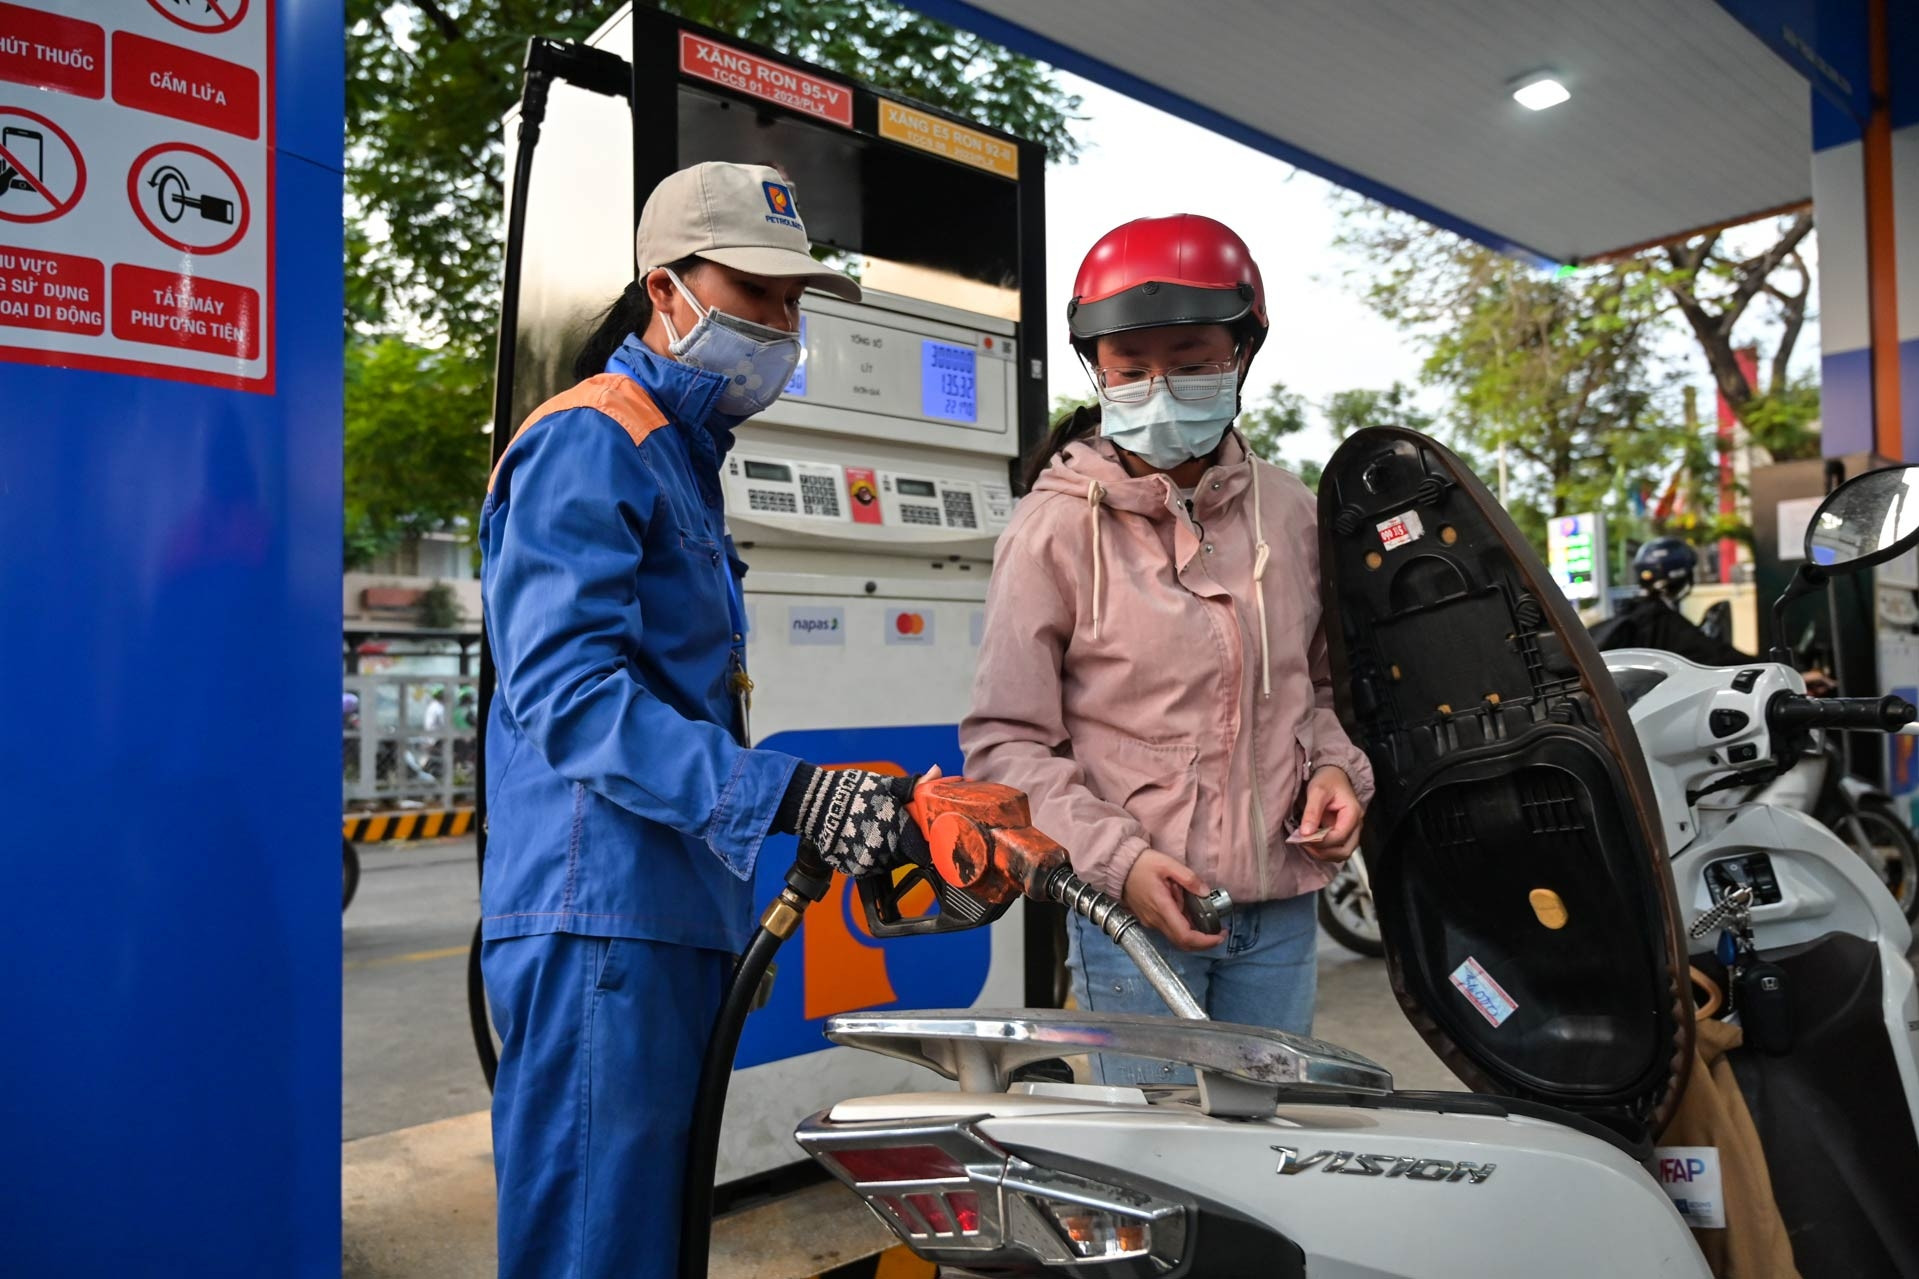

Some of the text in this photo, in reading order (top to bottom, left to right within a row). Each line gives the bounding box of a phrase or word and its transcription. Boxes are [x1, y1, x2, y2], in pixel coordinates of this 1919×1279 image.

[34, 43, 94, 71] THUỐC
[696, 44, 839, 105] XĂNG RON 95-V
[149, 71, 227, 106] CẤM LỬA
[712, 68, 746, 88] TCCS
[750, 81, 763, 93] 01
[774, 89, 825, 114] 2023/PLX
[933, 124, 950, 140] E5
[953, 132, 982, 151] RON
[19, 257, 58, 275] VỰC
[11, 276, 38, 294] SỬ
[43, 282, 89, 302] DỤNG
[34, 304, 51, 319] DI
[55, 305, 102, 325] ĐỘNG
[189, 296, 224, 315] MÁY
[131, 309, 246, 342] PHƯƠNG TIỆN
[792, 618, 829, 633] napas
[1270, 1144, 1497, 1184] VISION
